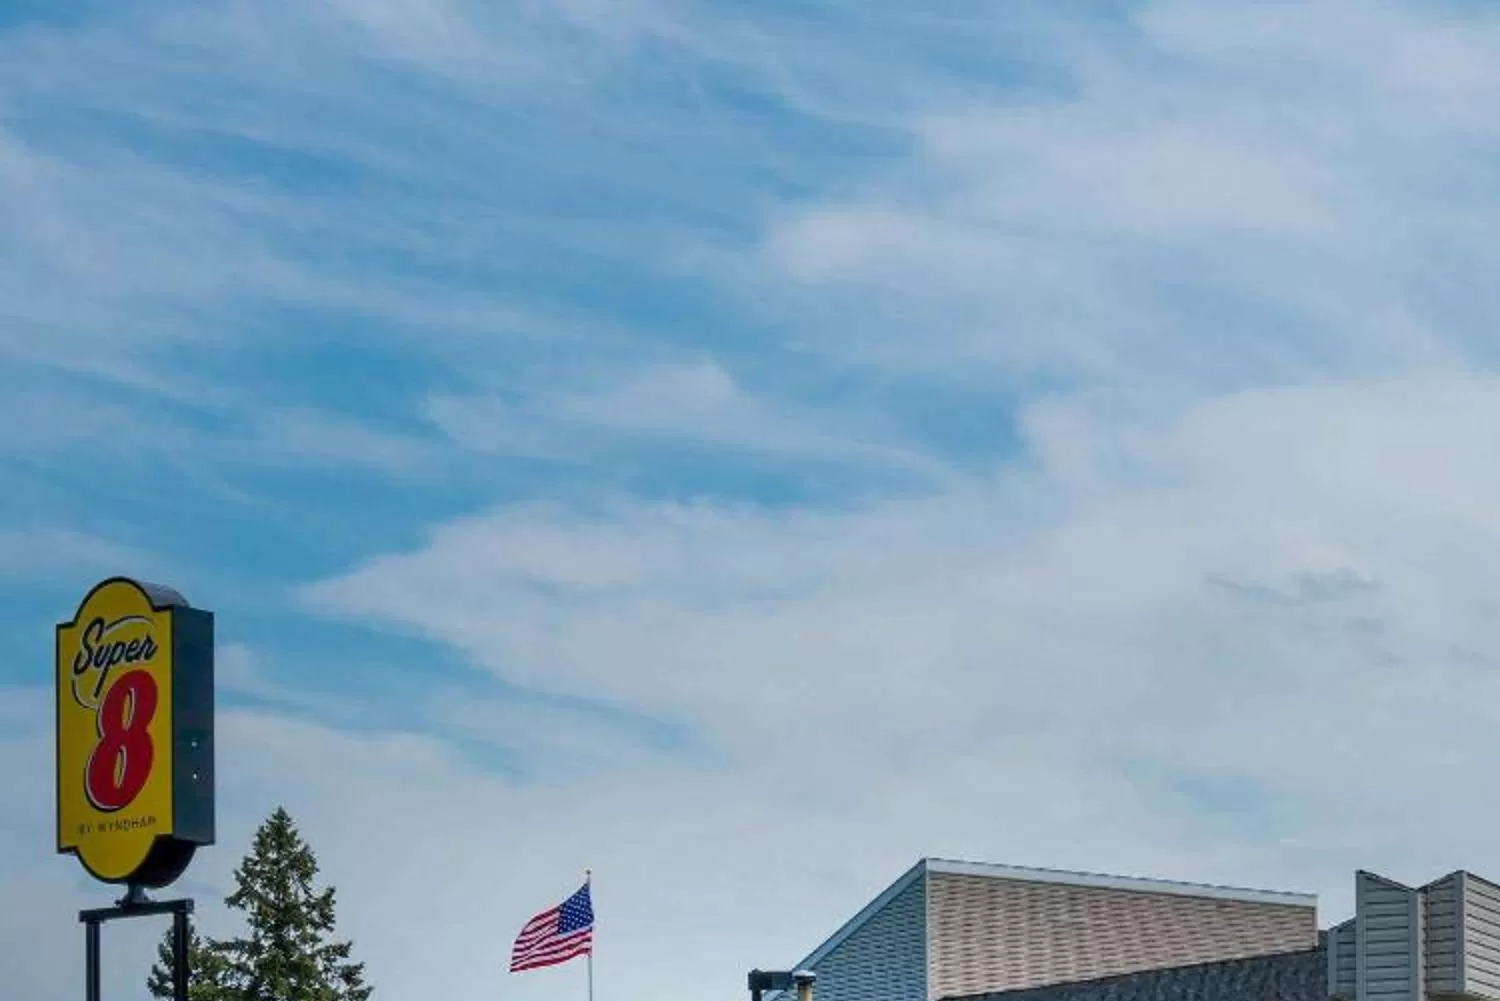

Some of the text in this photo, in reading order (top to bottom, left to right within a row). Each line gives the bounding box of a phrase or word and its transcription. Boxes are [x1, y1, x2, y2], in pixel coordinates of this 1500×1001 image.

[73, 616, 158, 698] Super
[84, 669, 158, 812] 8
[97, 815, 157, 834] WYNDHAM
